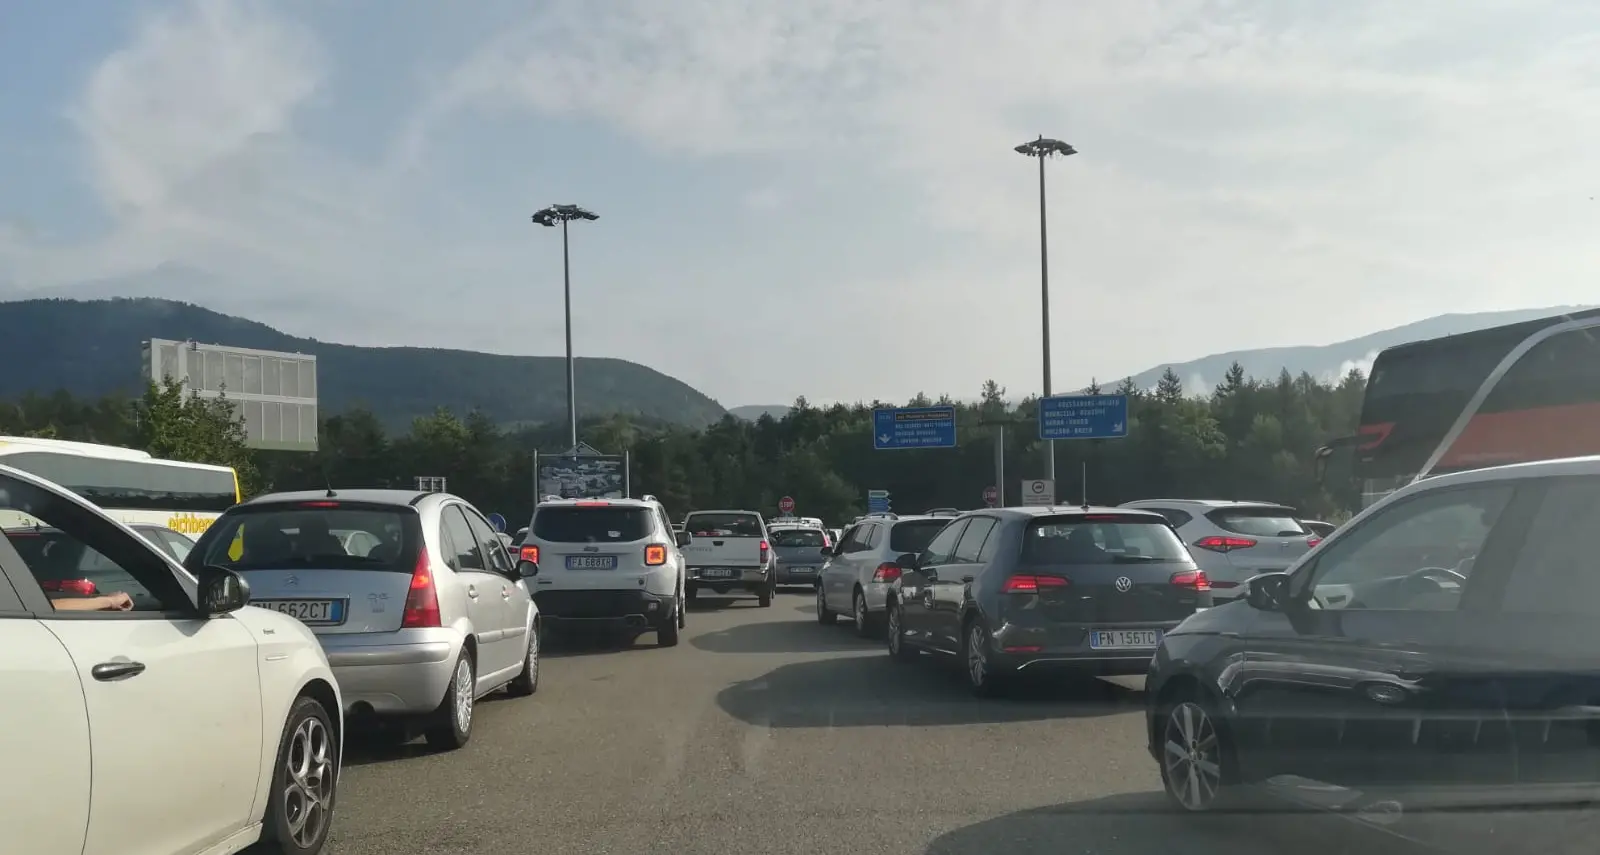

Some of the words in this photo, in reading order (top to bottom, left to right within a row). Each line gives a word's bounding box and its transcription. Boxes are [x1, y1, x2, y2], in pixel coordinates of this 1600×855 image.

[278, 602, 330, 619] 662CT
[1099, 631, 1114, 646] FN
[1120, 631, 1156, 645] 156TC
